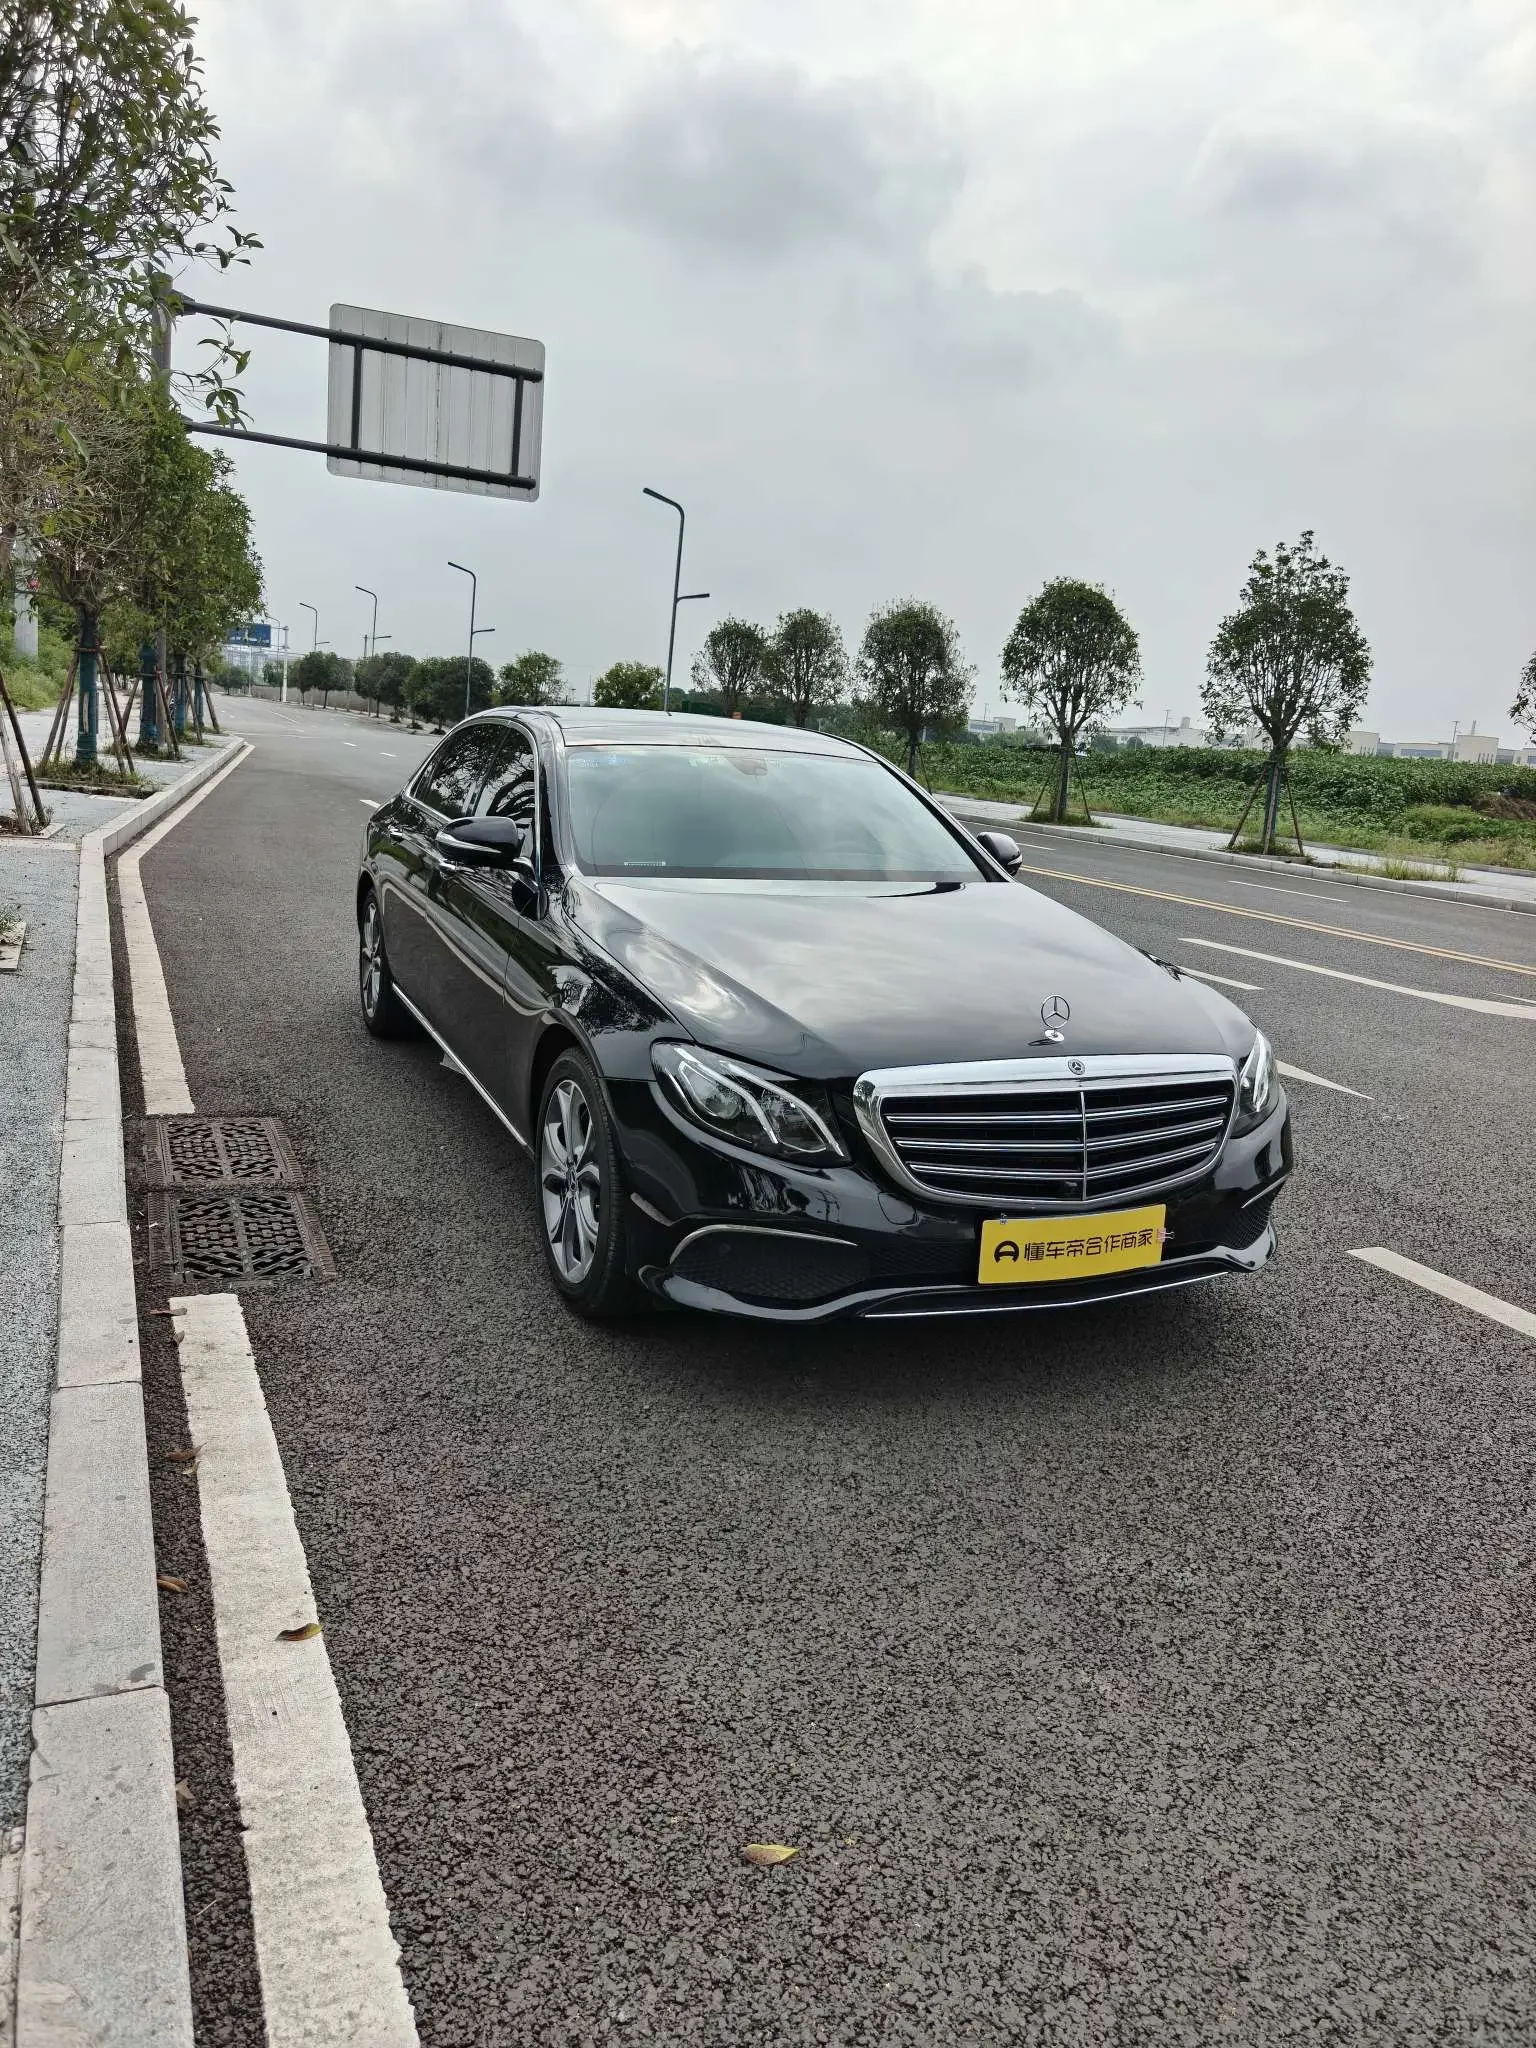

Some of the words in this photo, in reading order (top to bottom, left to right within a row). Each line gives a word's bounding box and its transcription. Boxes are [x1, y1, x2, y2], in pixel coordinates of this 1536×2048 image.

[1024, 1227, 1153, 1262] 懂车帝合作商家
